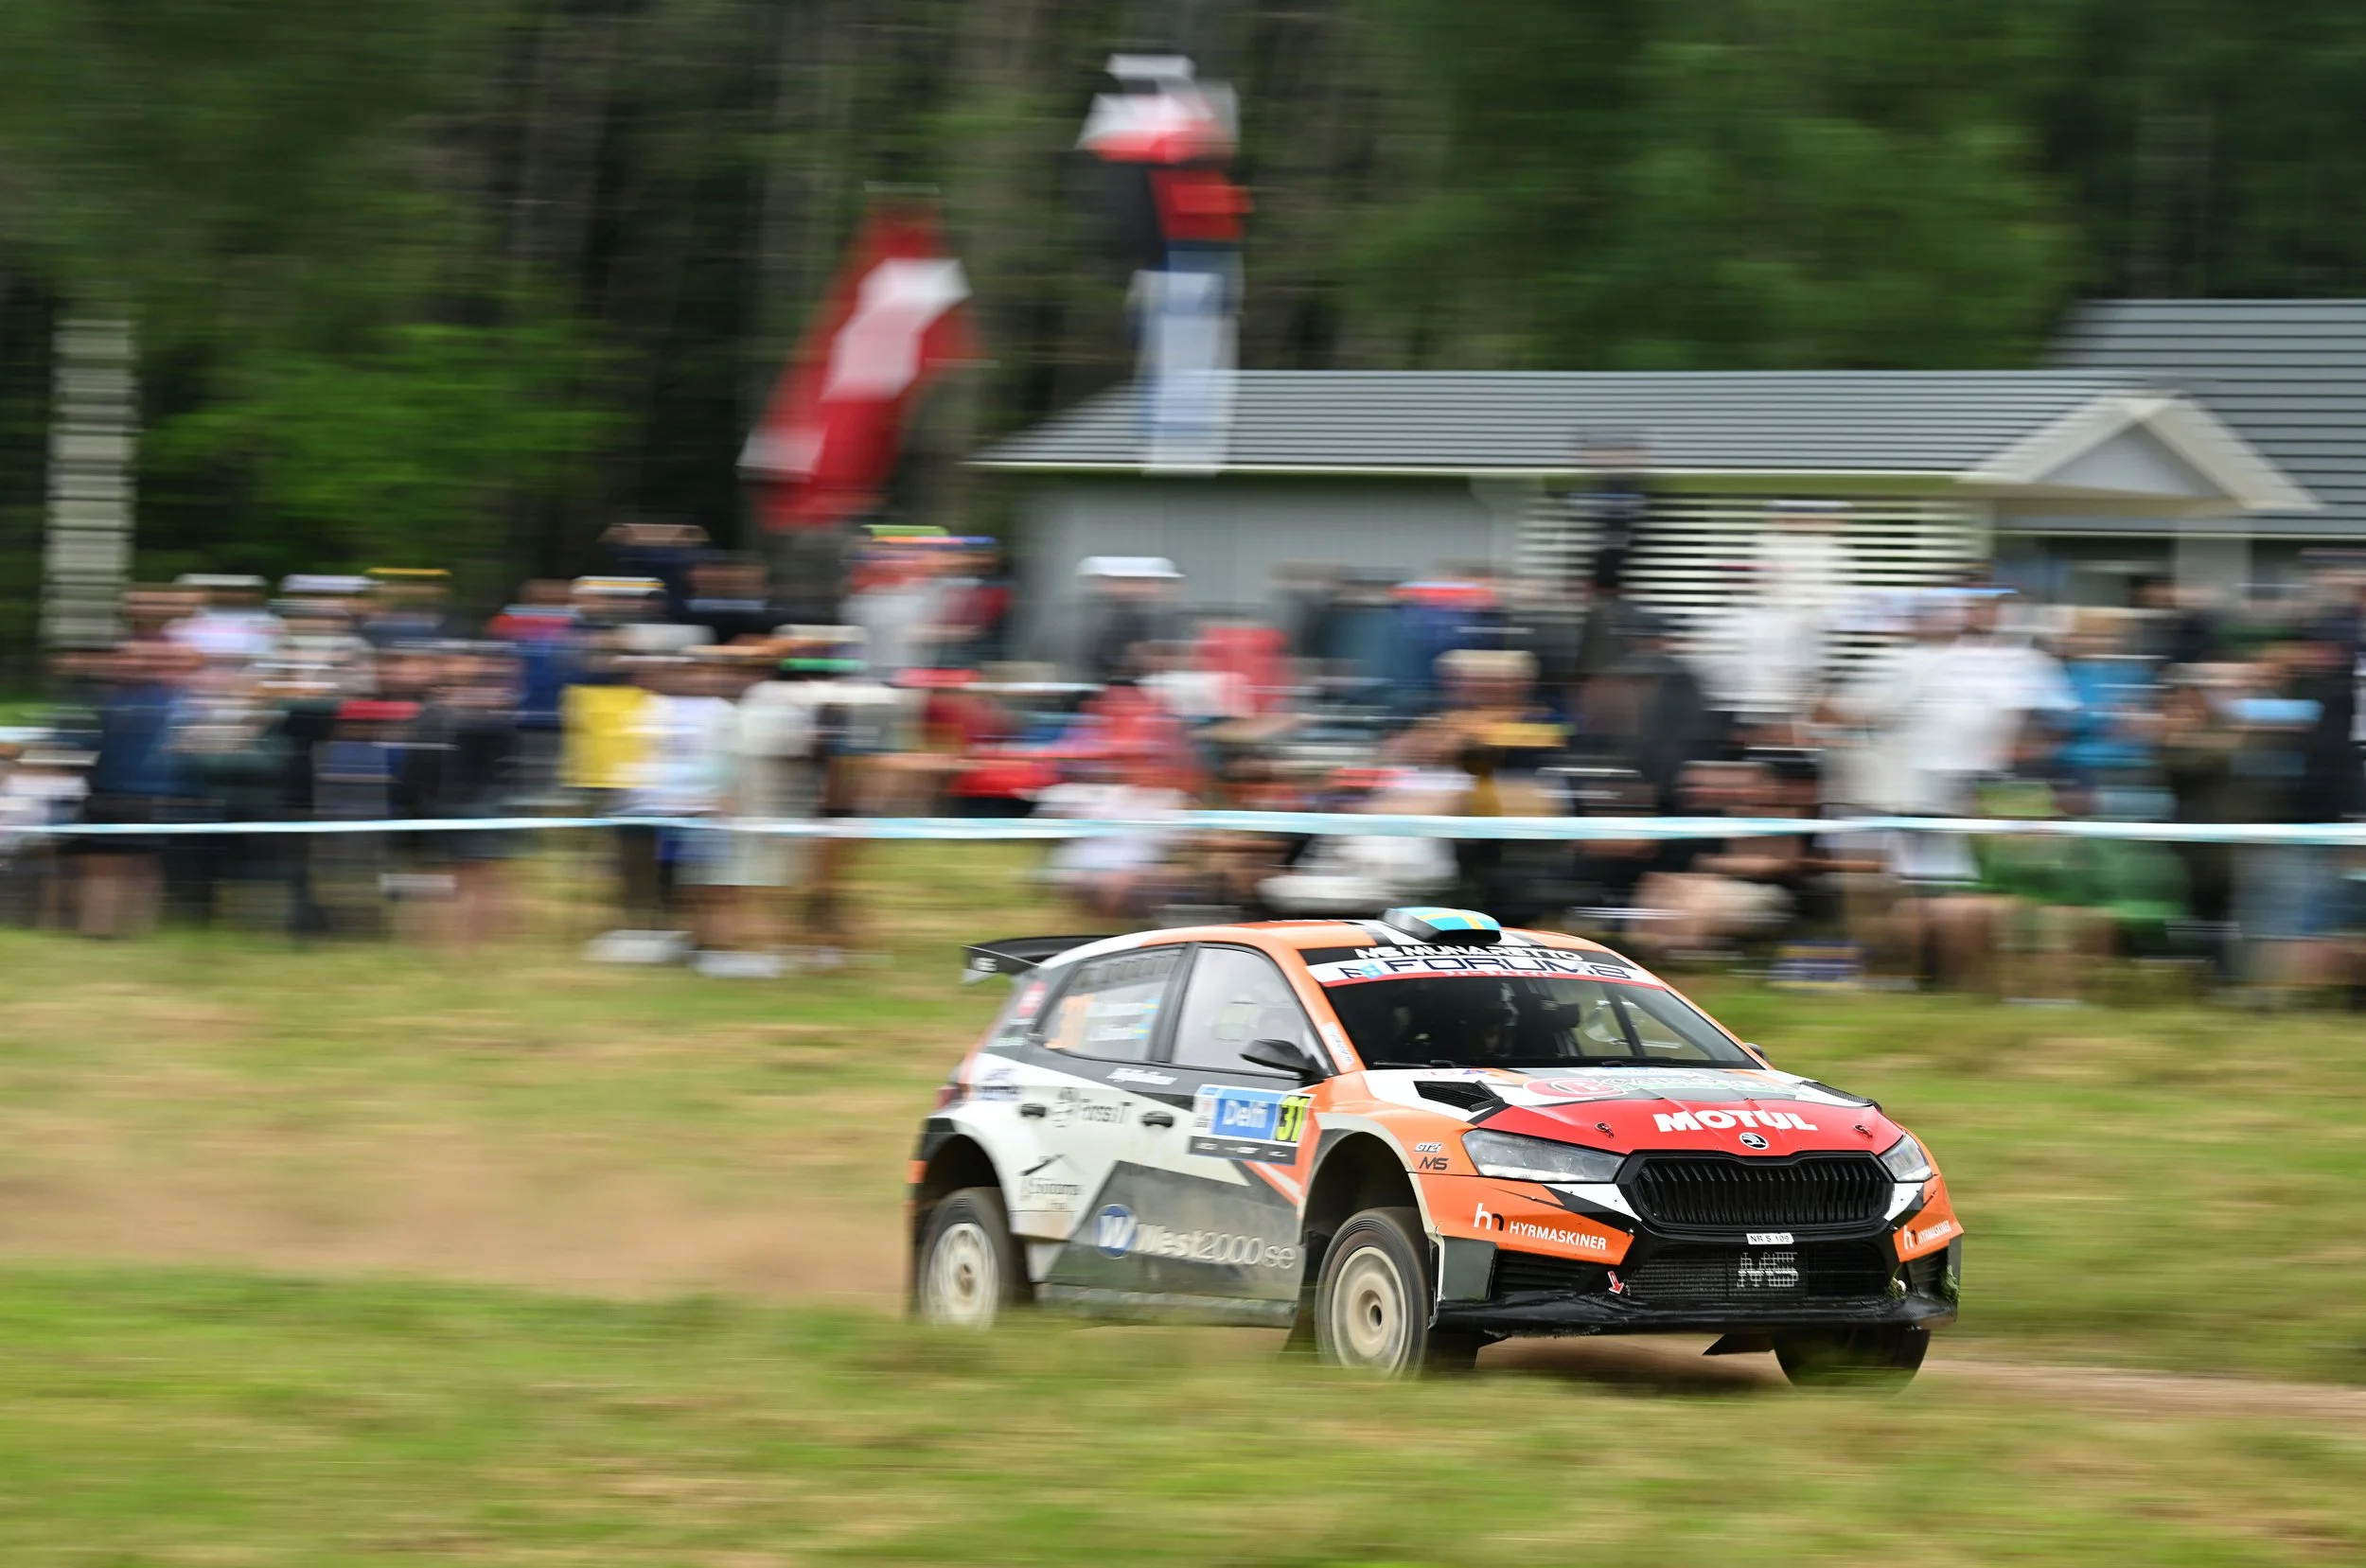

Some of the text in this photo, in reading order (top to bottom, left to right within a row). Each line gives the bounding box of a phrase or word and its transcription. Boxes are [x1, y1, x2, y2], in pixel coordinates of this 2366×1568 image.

[1355, 945, 1583, 961] MS MUNARETTO
[1222, 1100, 1268, 1129] Delfi
[1275, 1096, 1311, 1142] 31
[1652, 1109, 1819, 1133] MOTUL
[1419, 1156, 1450, 1171] MS
[1509, 1221, 1607, 1251] HYRMASKINER
[1750, 1235, 1763, 1243] NR
[1737, 1251, 1799, 1288] MS
